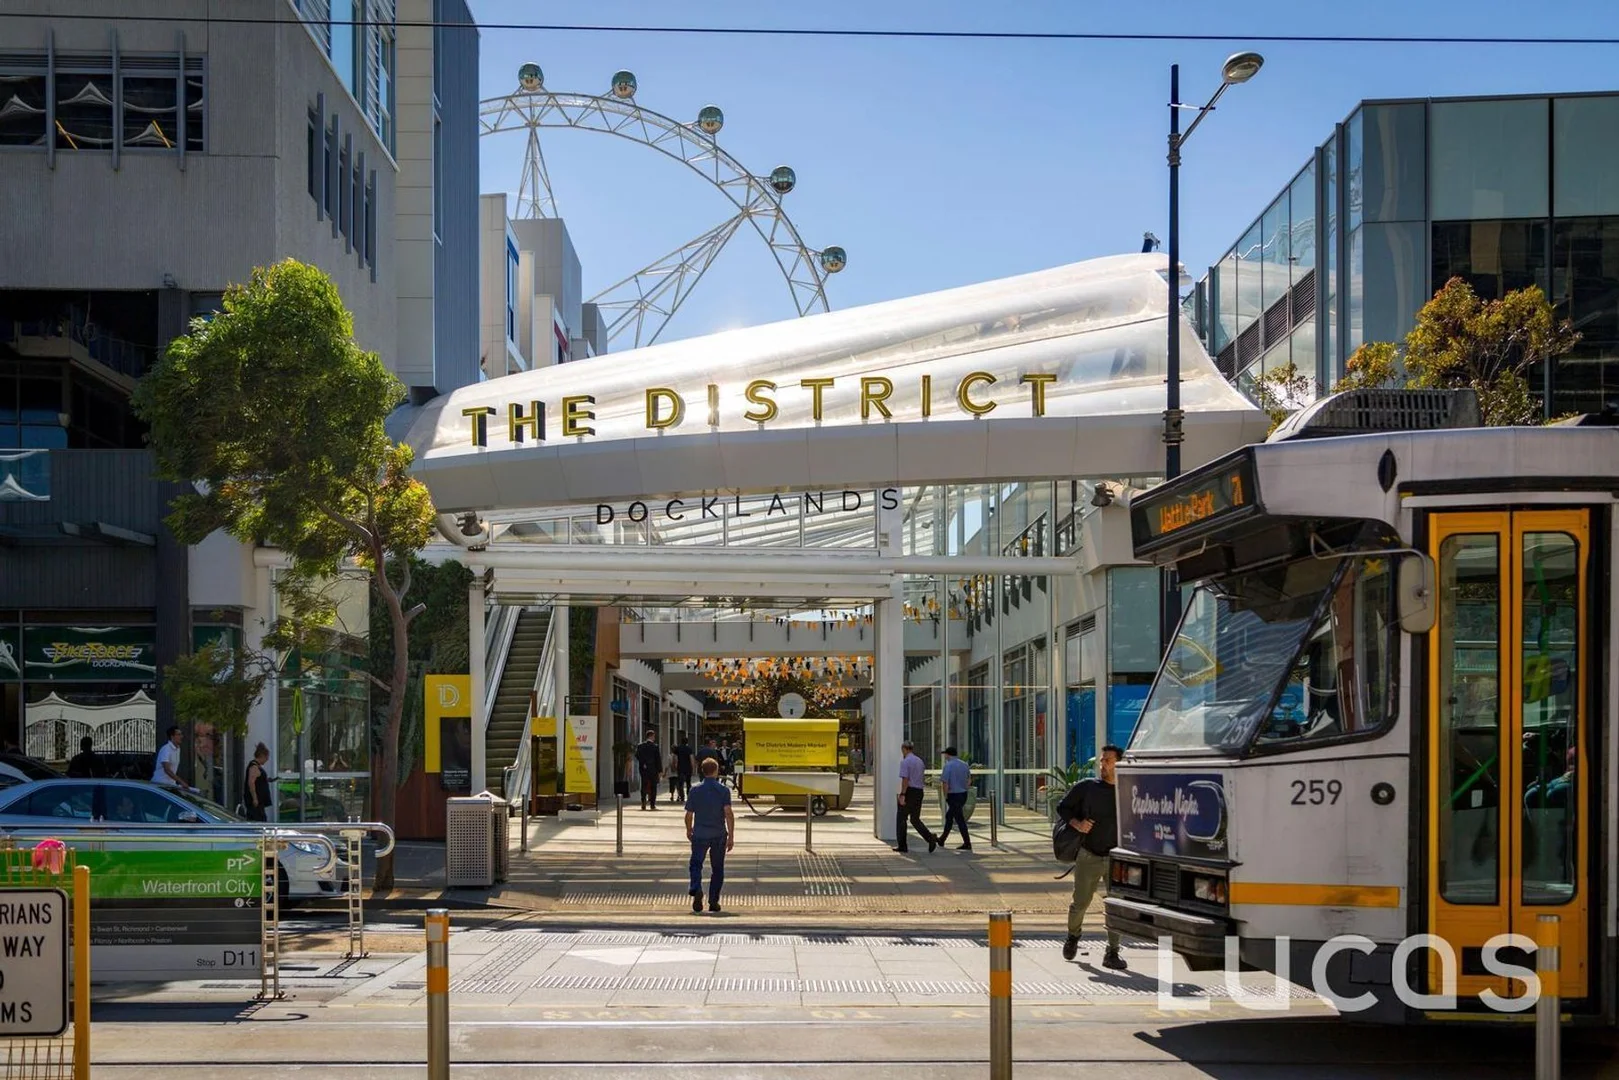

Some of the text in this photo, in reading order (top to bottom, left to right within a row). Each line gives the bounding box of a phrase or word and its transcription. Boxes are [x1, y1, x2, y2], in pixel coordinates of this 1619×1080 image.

[462, 371, 1057, 447] THE DISTRICT
[596, 488, 898, 525] DOCKLANDS
[1291, 779, 1343, 805] 259
[143, 879, 255, 897] Waterfront City
[3, 936, 45, 957] WAY
[196, 951, 256, 967] Stop D11
